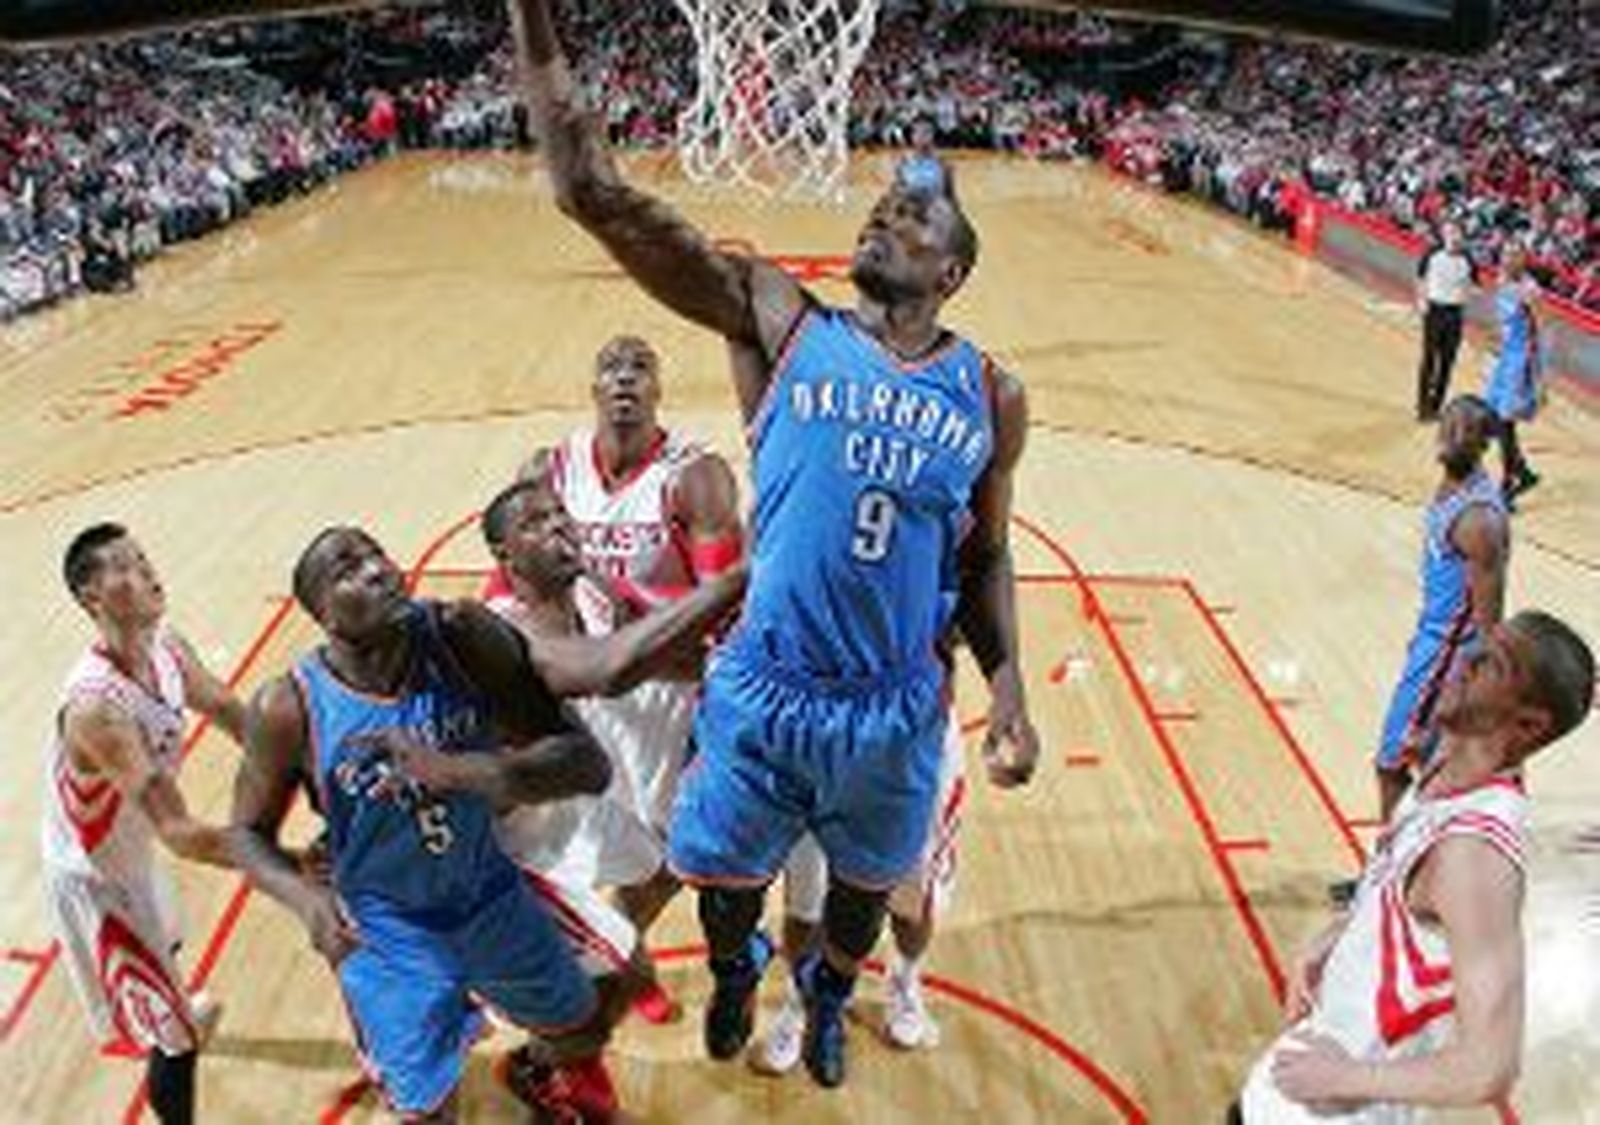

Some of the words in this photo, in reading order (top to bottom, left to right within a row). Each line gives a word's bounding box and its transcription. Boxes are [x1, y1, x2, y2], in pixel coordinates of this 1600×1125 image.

[791, 381, 985, 466] OKLAHOMA
[846, 432, 928, 487] CITY
[852, 490, 896, 563] 9
[418, 803, 454, 855] 5
